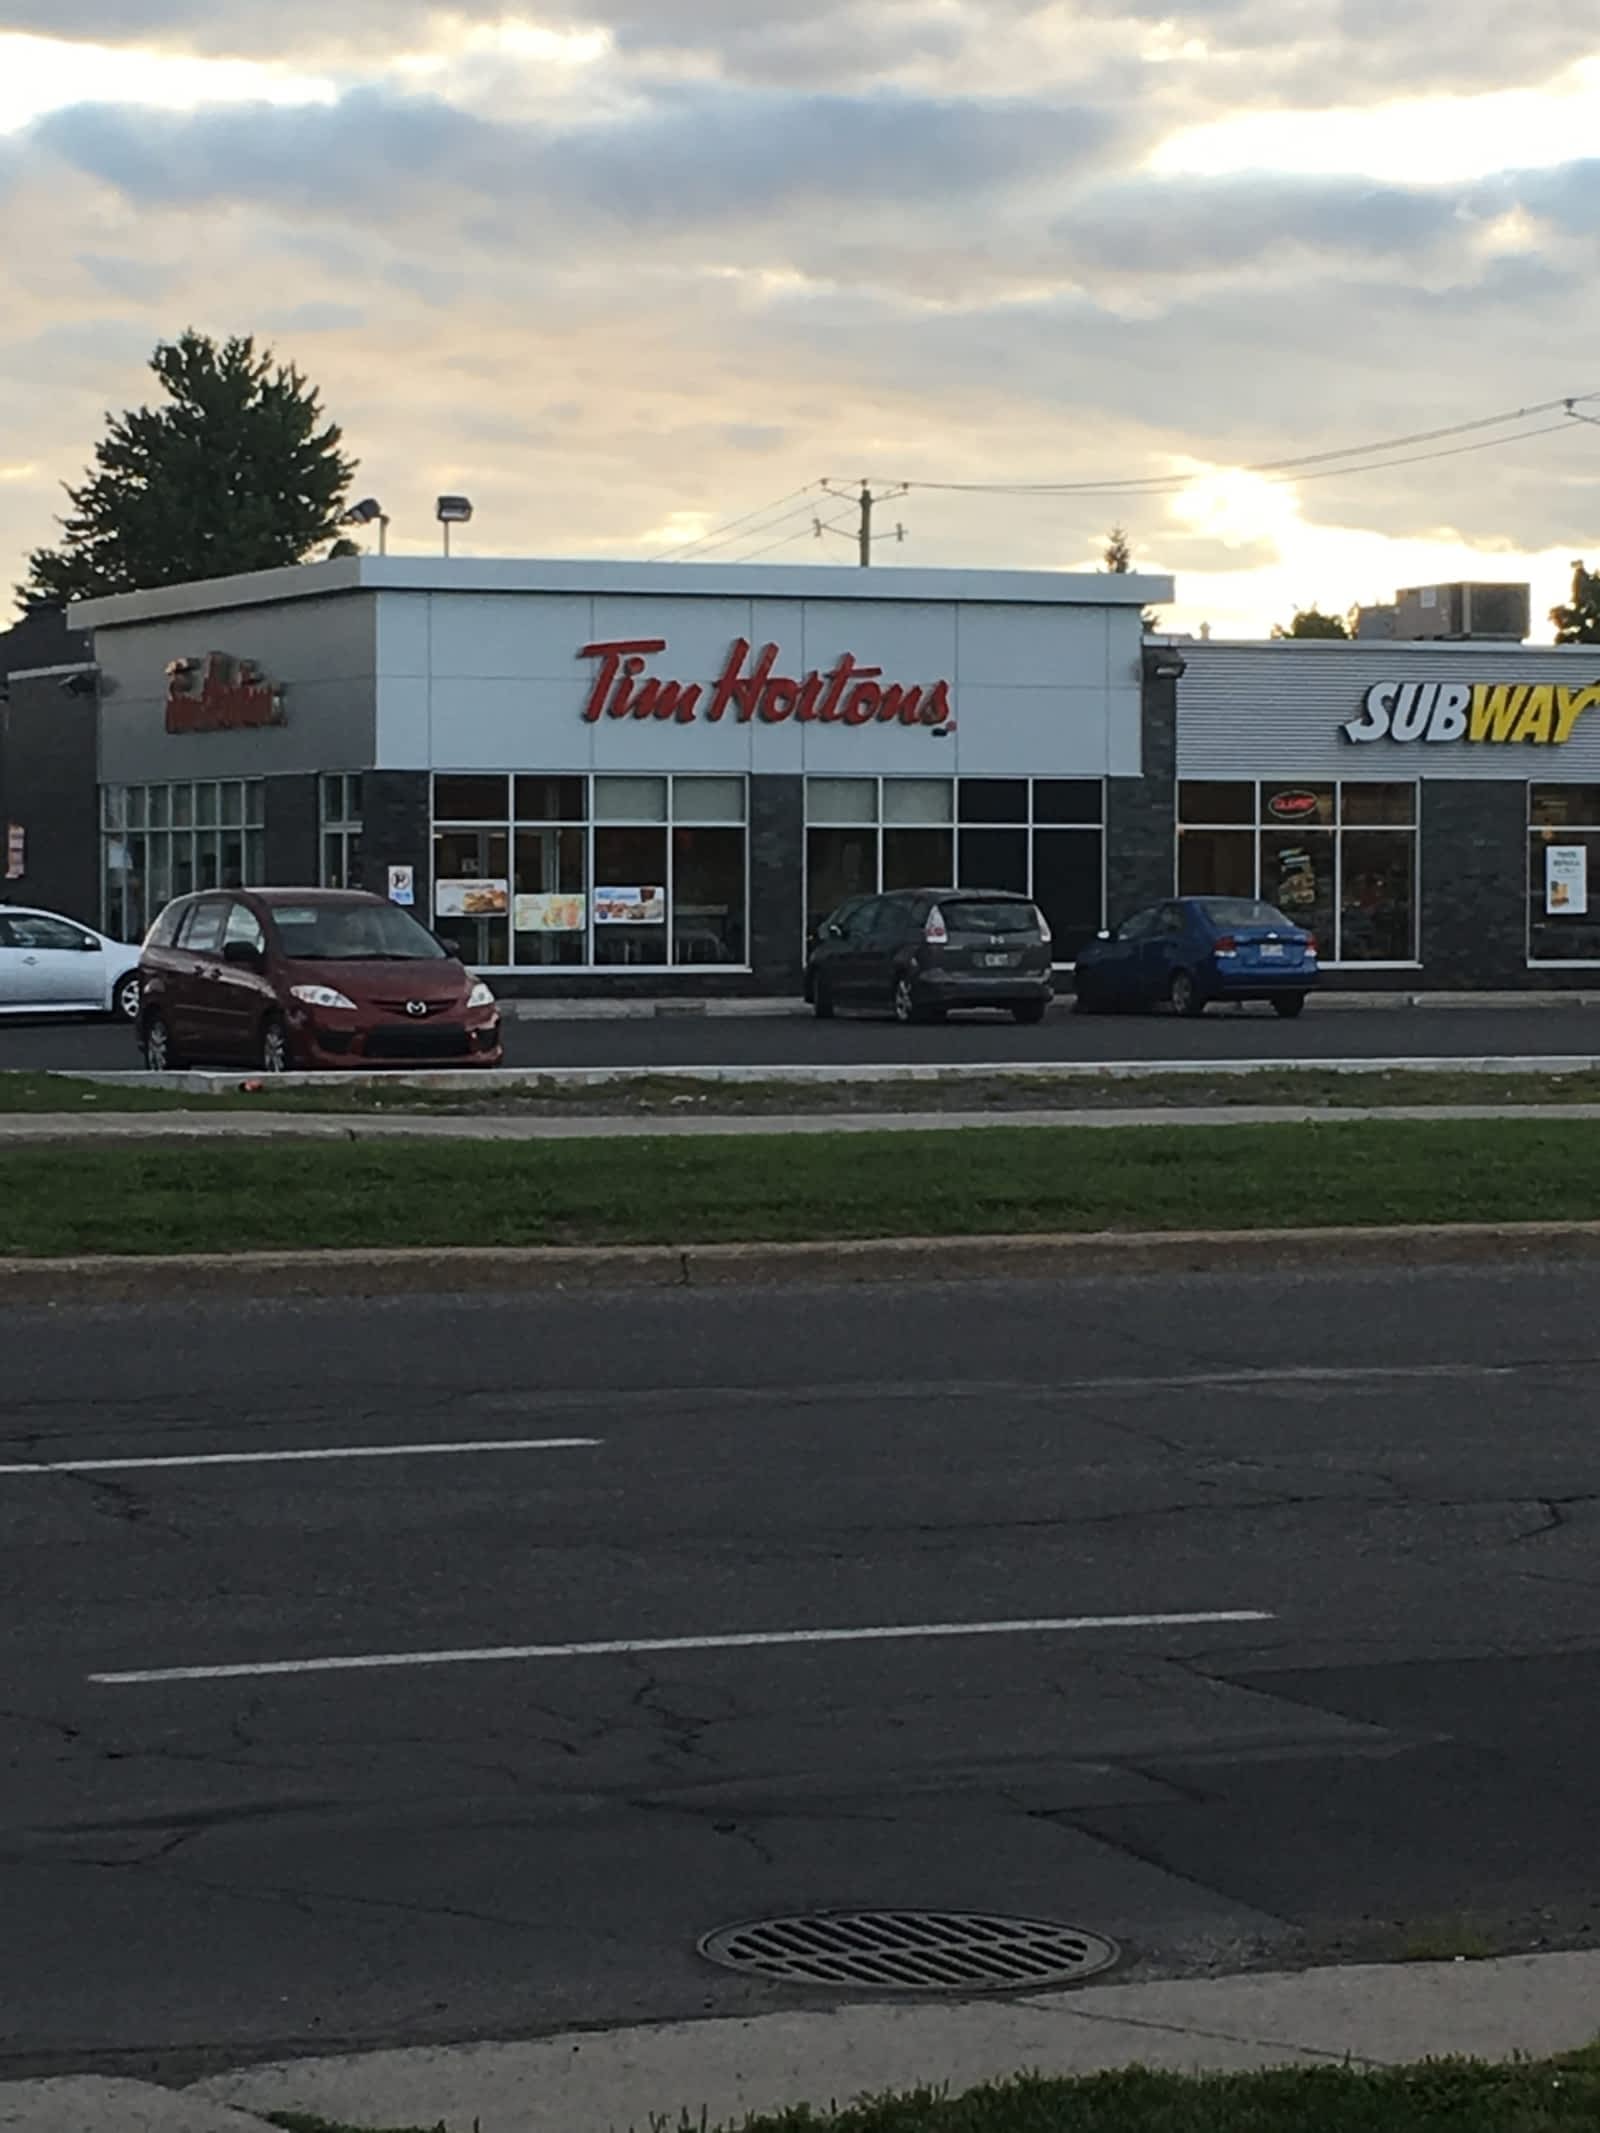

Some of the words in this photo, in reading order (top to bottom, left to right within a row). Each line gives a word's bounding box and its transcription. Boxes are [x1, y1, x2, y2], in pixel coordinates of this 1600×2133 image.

[576, 638, 703, 723] Tim
[706, 637, 951, 726] Hortons
[1344, 680, 1600, 744] SUBWAY
